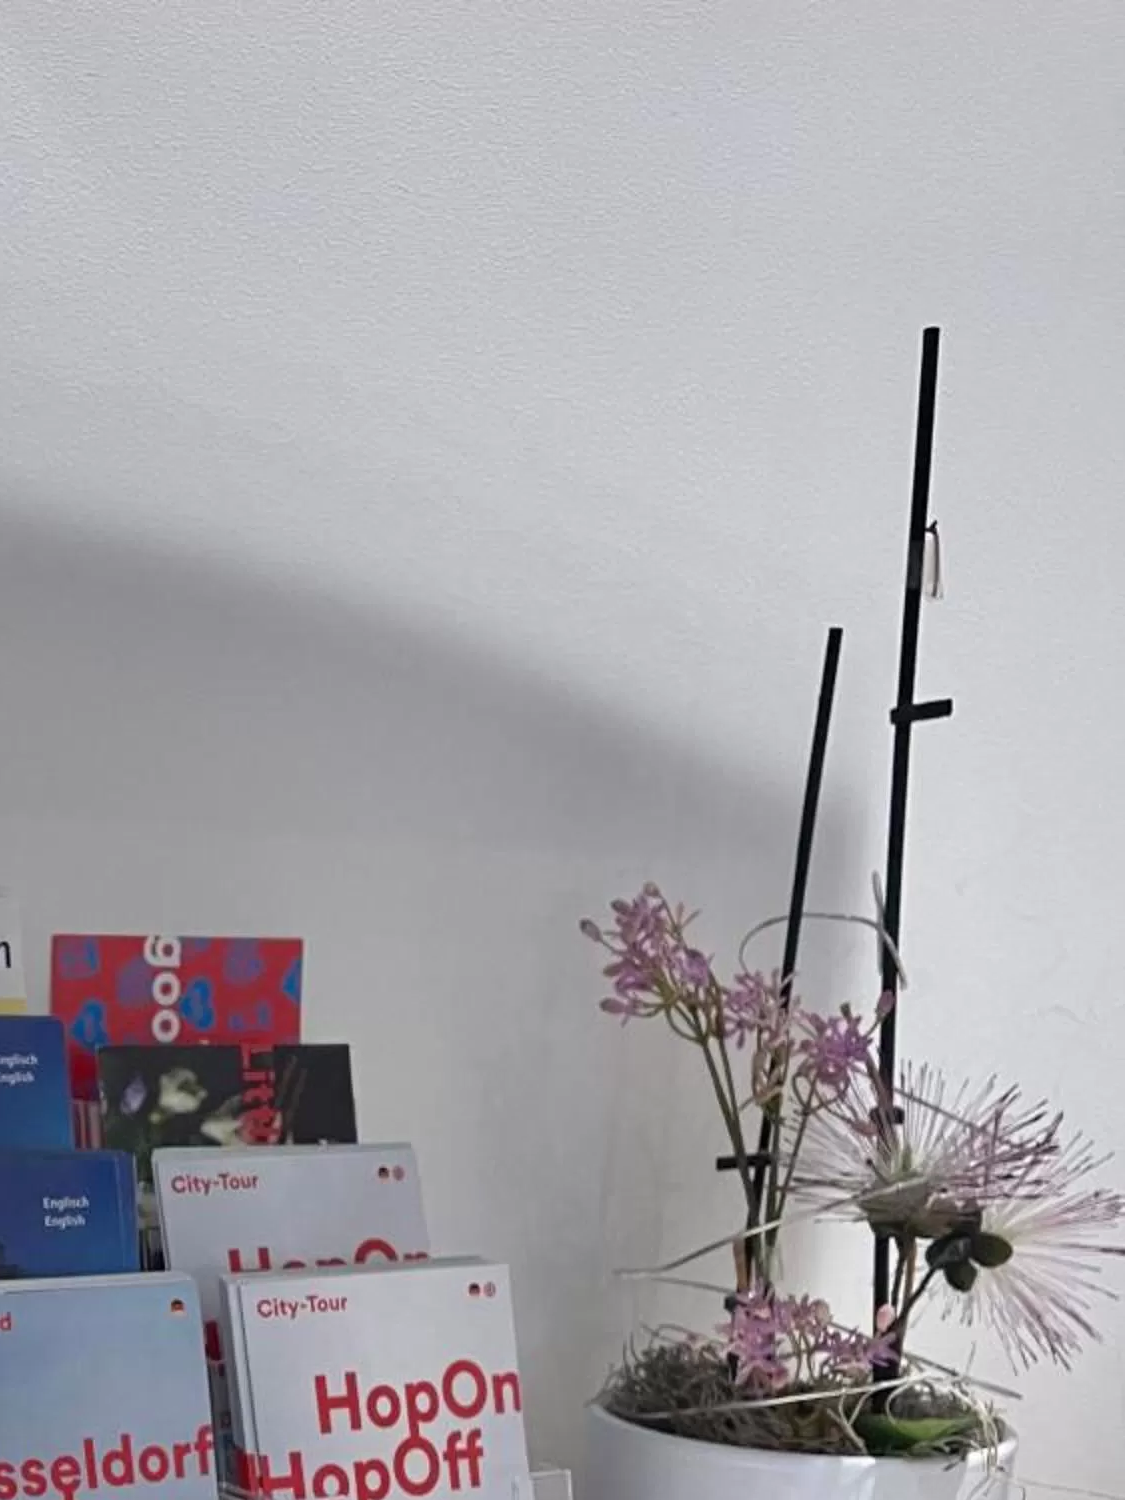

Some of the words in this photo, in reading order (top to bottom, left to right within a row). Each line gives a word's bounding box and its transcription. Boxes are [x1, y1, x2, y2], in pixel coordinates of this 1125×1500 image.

[170, 1172, 259, 1195] City-Tour
[42, 1197, 90, 1212] Englisch
[44, 1214, 86, 1230] English
[256, 1295, 348, 1320] City-Tour
[314, 1359, 522, 1437] HopOn
